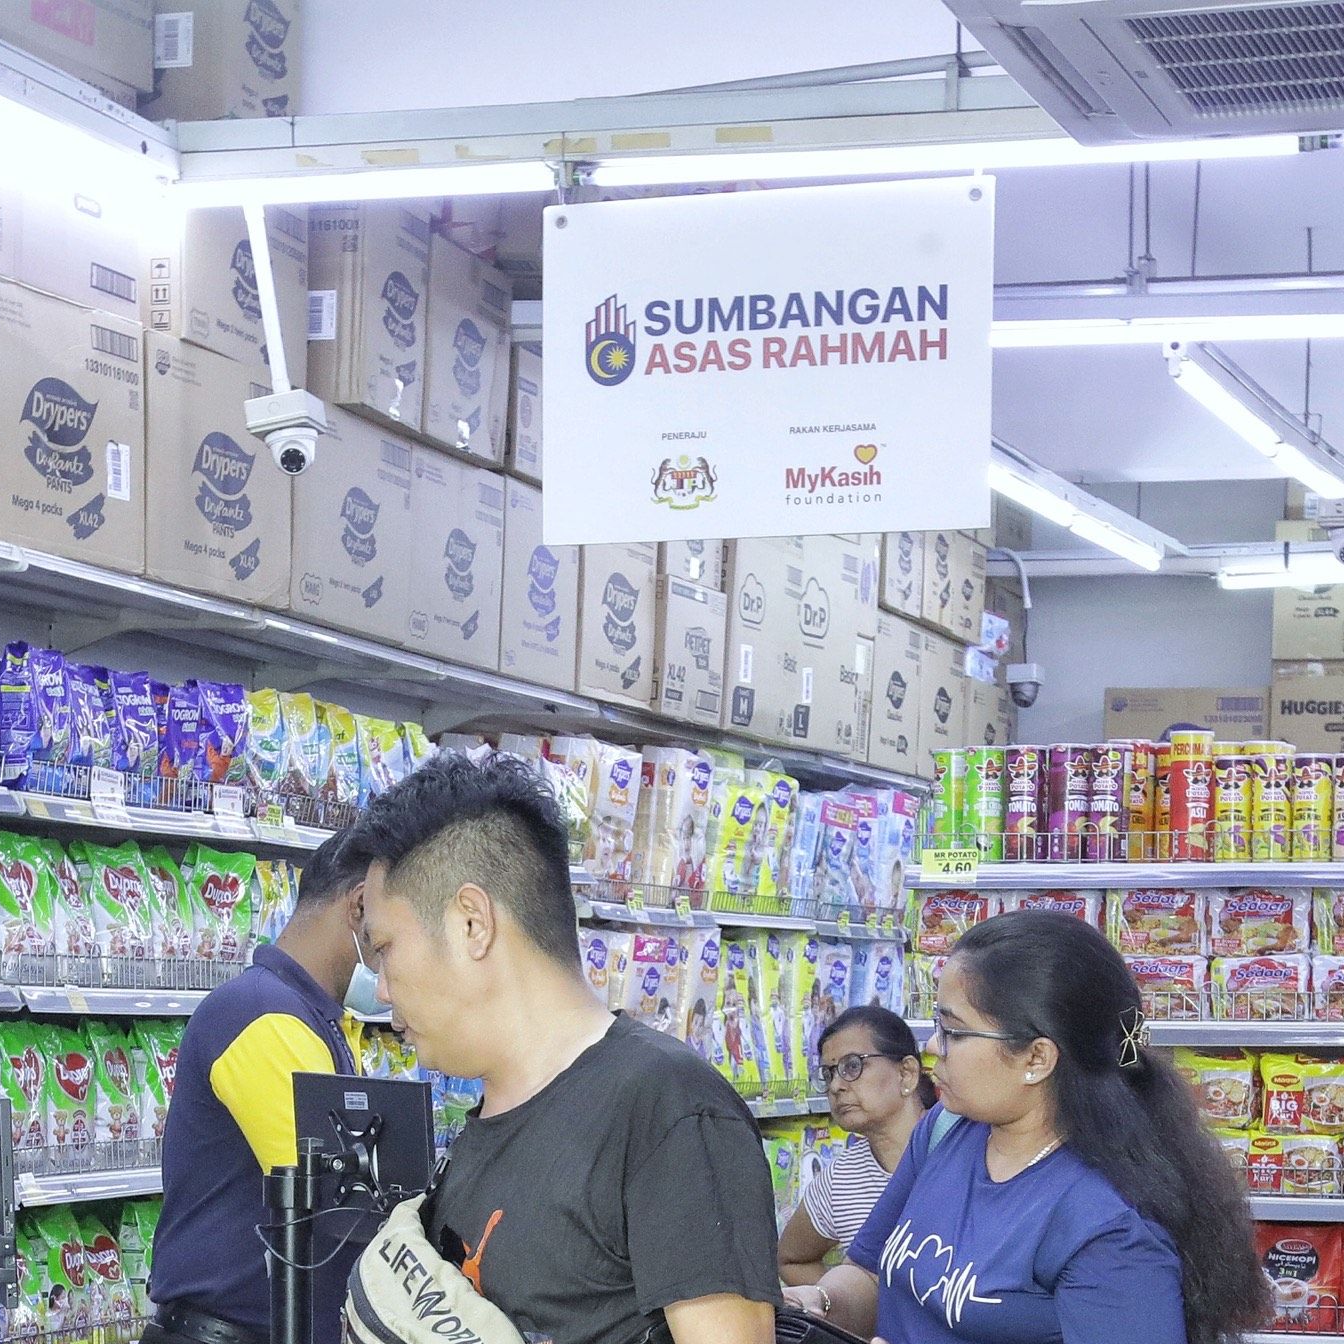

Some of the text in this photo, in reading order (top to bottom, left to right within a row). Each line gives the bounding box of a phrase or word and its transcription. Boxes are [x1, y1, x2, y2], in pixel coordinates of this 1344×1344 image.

[644, 284, 949, 337] SUMBANGAN
[645, 328, 948, 376] ASAS RAHMAH
[789, 423, 877, 435] RAKAN KERJASAMA
[661, 431, 707, 441] PENERAJU
[785, 464, 881, 493] MyKasih
[785, 493, 882, 507] foundation
[1009, 803, 1036, 812] TOMATO
[1091, 802, 1119, 812] TOMATO
[942, 862, 971, 874] 4.60
[1226, 899, 1292, 915] Sedaap
[1234, 966, 1294, 981] Sedaap
[1270, 1100, 1298, 1111] BIG
[1268, 1253, 1316, 1263] NICEKOPI
